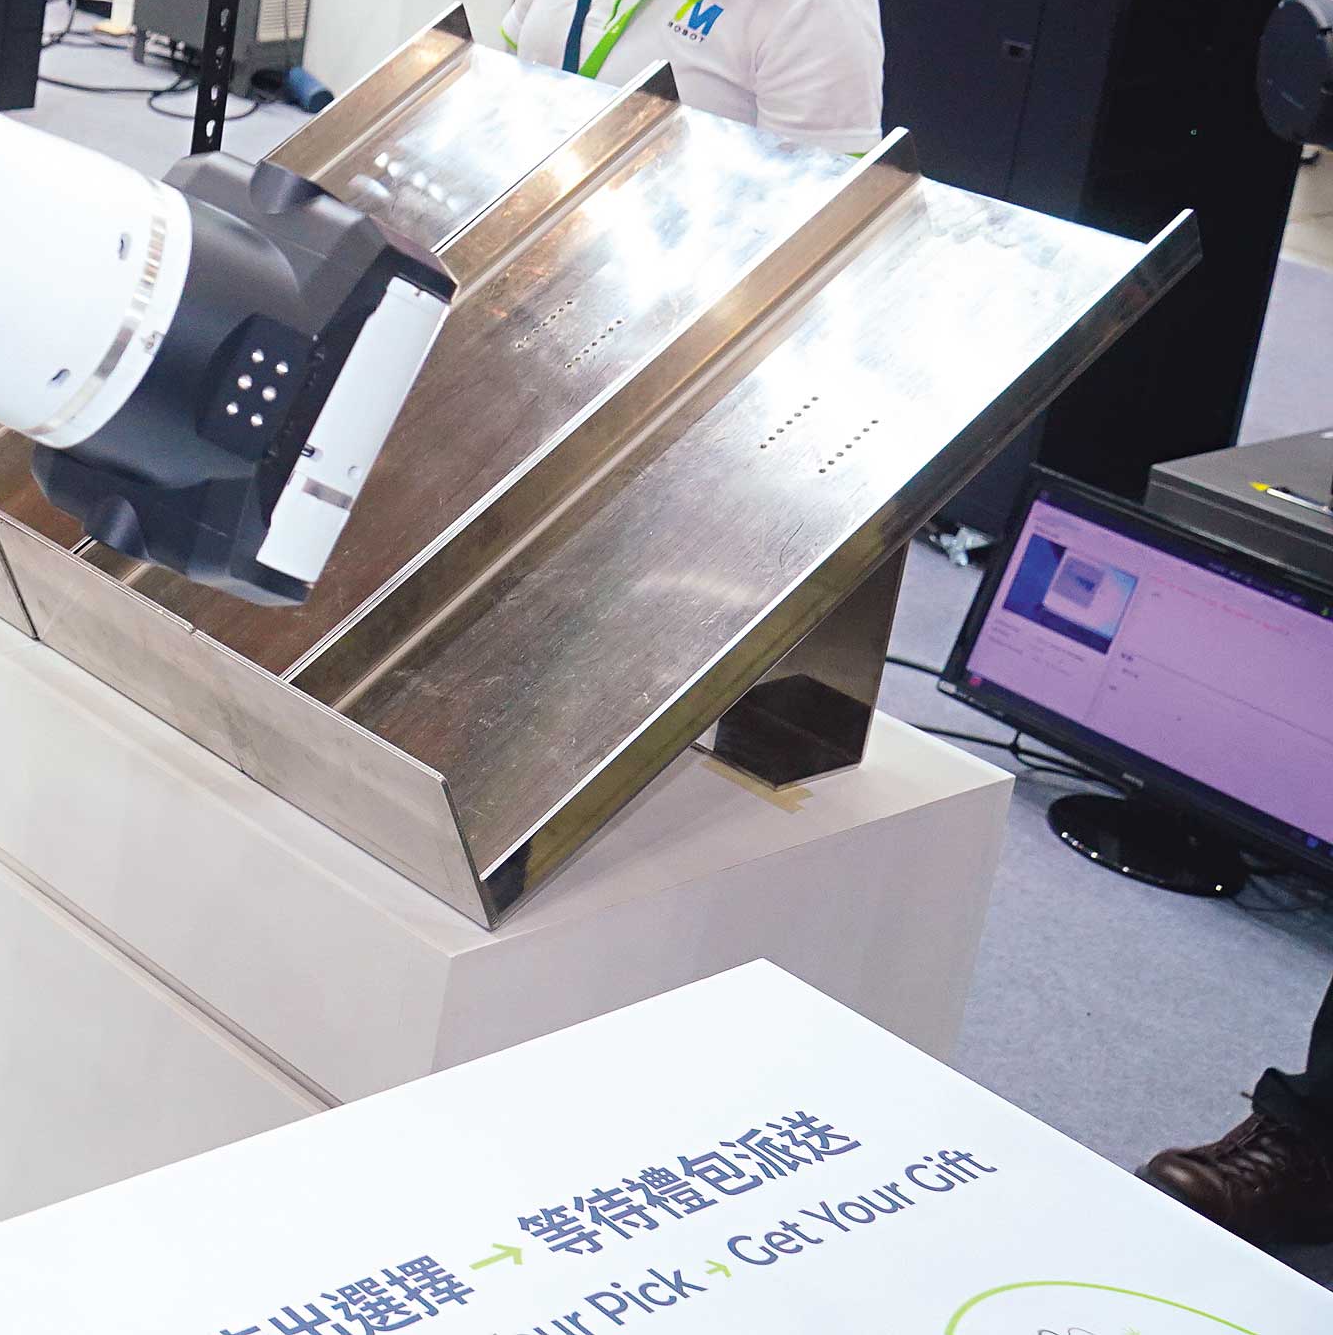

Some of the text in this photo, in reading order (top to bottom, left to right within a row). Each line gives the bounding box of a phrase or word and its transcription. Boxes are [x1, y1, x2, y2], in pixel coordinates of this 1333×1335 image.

[516, 1110, 863, 1257] 等待禮包派送
[584, 1267, 708, 1328] Pick
[726, 1219, 825, 1267] Get
[798, 1179, 916, 1235] Your
[903, 1147, 1000, 1194] Gift
[218, 1254, 476, 1335] 出選擇
